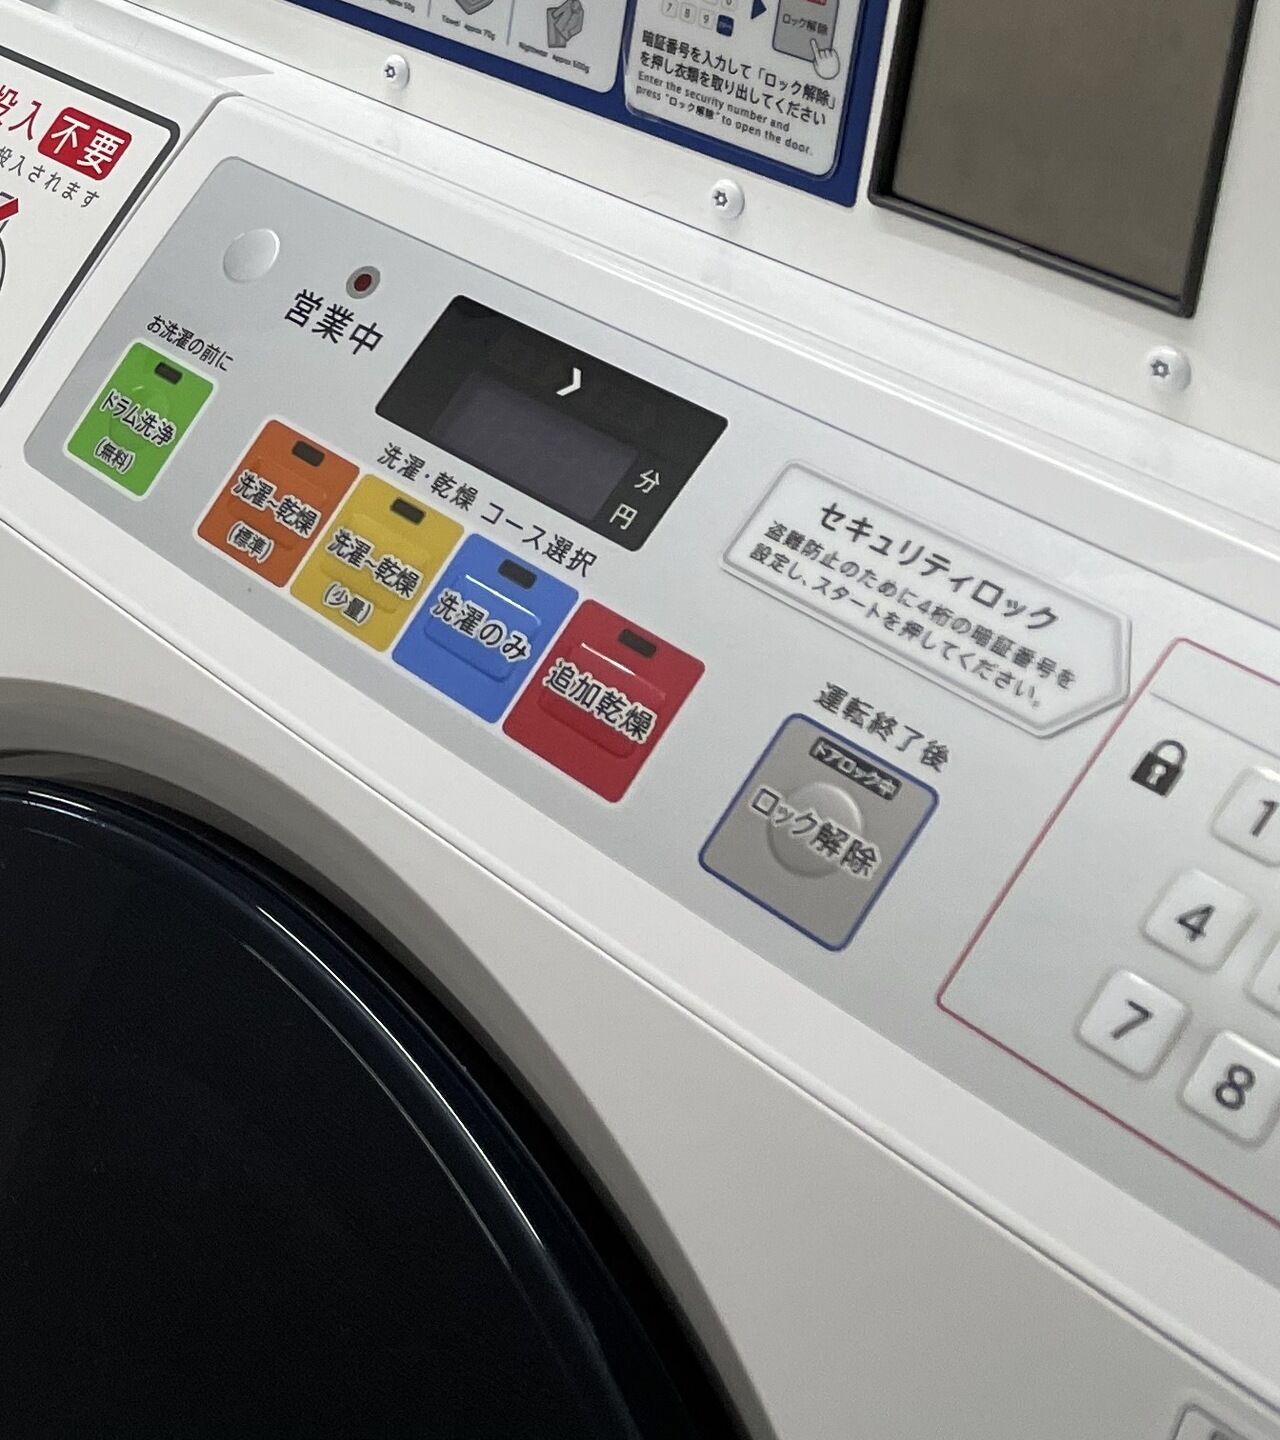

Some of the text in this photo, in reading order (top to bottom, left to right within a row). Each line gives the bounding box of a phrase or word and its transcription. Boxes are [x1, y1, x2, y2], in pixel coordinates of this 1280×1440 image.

[782, 12, 829, 36] ロック解除
[640, 53, 827, 127] を押し衣類を取り出してください
[48, 114, 125, 175] 不要
[146, 312, 234, 372] お洗濯の前に
[283, 289, 384, 357] 営業中
[100, 390, 175, 448] ドラム洗浄
[94, 439, 135, 474] (無料)
[634, 468, 662, 495] 分
[226, 521, 273, 562] (標準)
[480, 501, 597, 578] コース選択
[610, 503, 638, 530] 円
[820, 501, 1059, 632] セキュリティロック
[322, 581, 373, 623] (少量)
[436, 592, 531, 661] 洗濯のみ
[748, 542, 1041, 710] 設定し、スタートを押してください。
[763, 519, 1077, 691] 盗難防止のために4桁の暗証番号を
[545, 660, 655, 741] 追加乾燥
[812, 682, 952, 773] 運転終了後
[750, 786, 883, 880] ロック解除
[1250, 799, 1280, 838] 1
[1175, 903, 1216, 943] 4
[1110, 999, 1154, 1040] 7
[1214, 1063, 1256, 1111] 8
